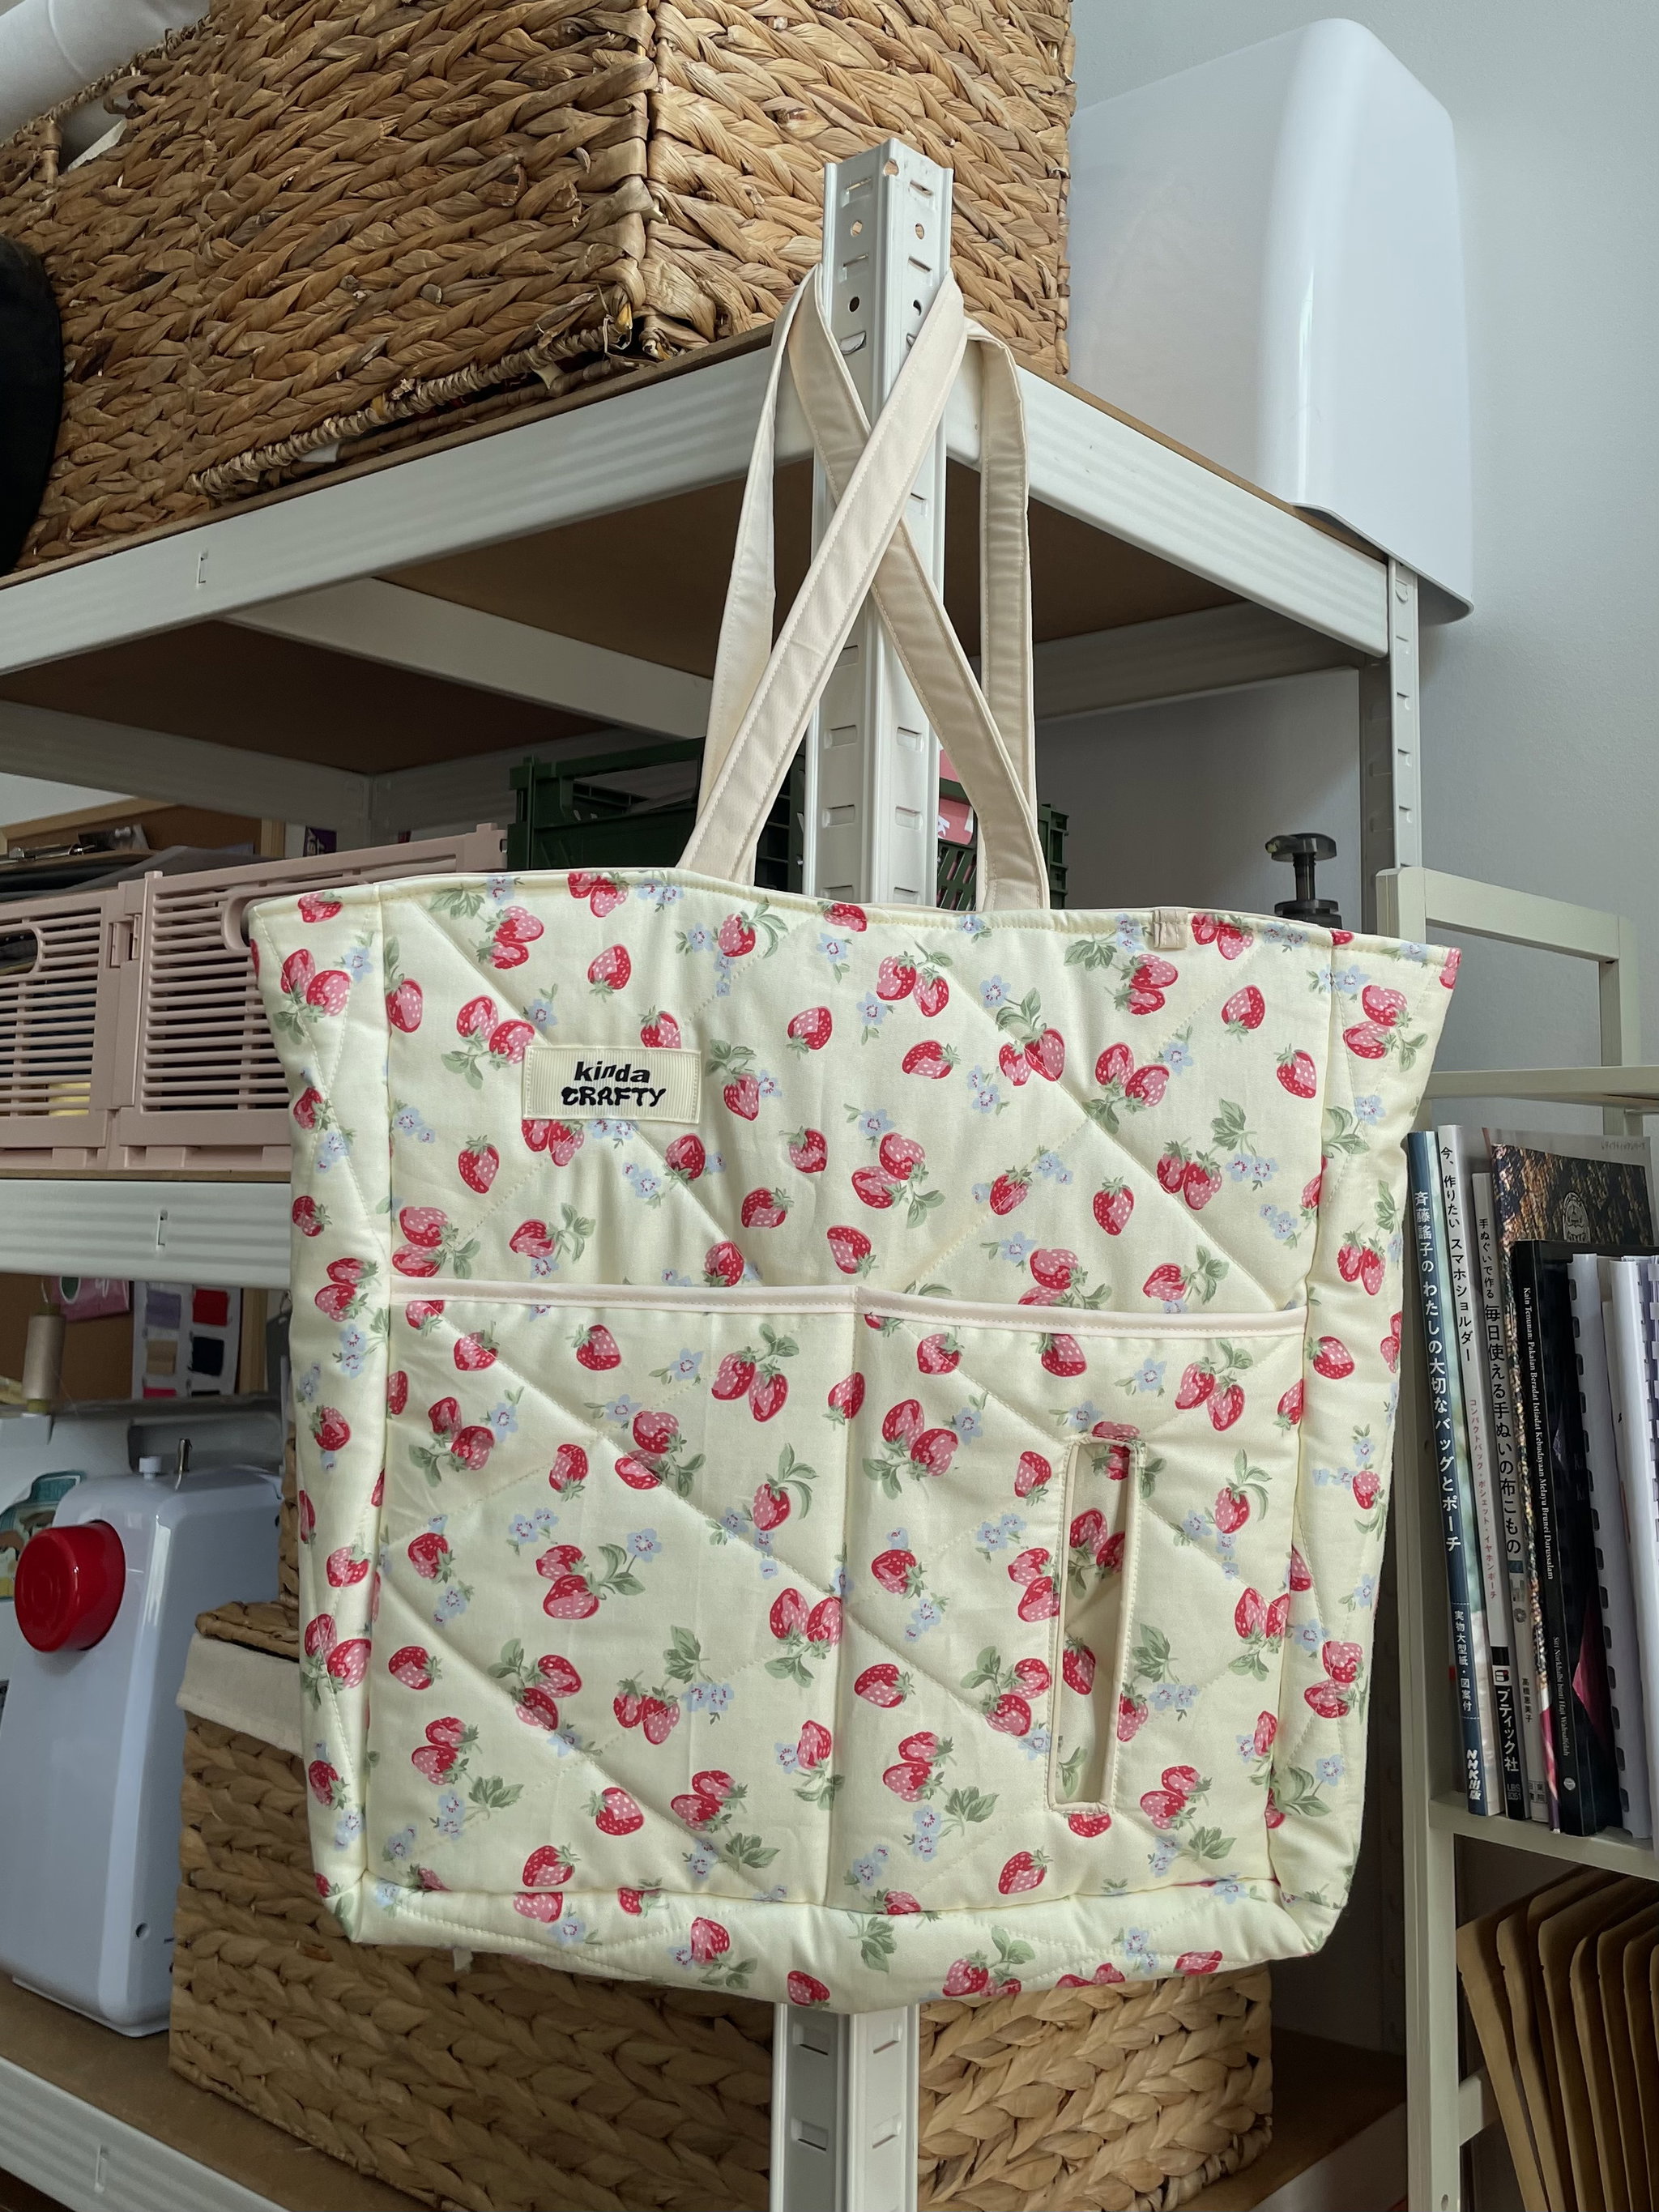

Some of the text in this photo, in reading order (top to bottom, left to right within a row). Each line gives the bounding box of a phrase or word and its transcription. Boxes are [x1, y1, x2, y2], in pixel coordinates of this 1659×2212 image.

[574, 1060, 650, 1084] kinda
[561, 1085, 667, 1107] CRAFTY
[1451, 1238, 1473, 1361] スマホショルダー
[1524, 1287, 1532, 1305] Kain
[1528, 1341, 1537, 1370] Pakaian
[1540, 1478, 1548, 1506] Melayu
[1542, 1507, 1550, 1533] Brunei
[1544, 1535, 1555, 1579] Darussalam
[1497, 1689, 1520, 1772] ブティック社
[1466, 1749, 1482, 1801] NHK出版
